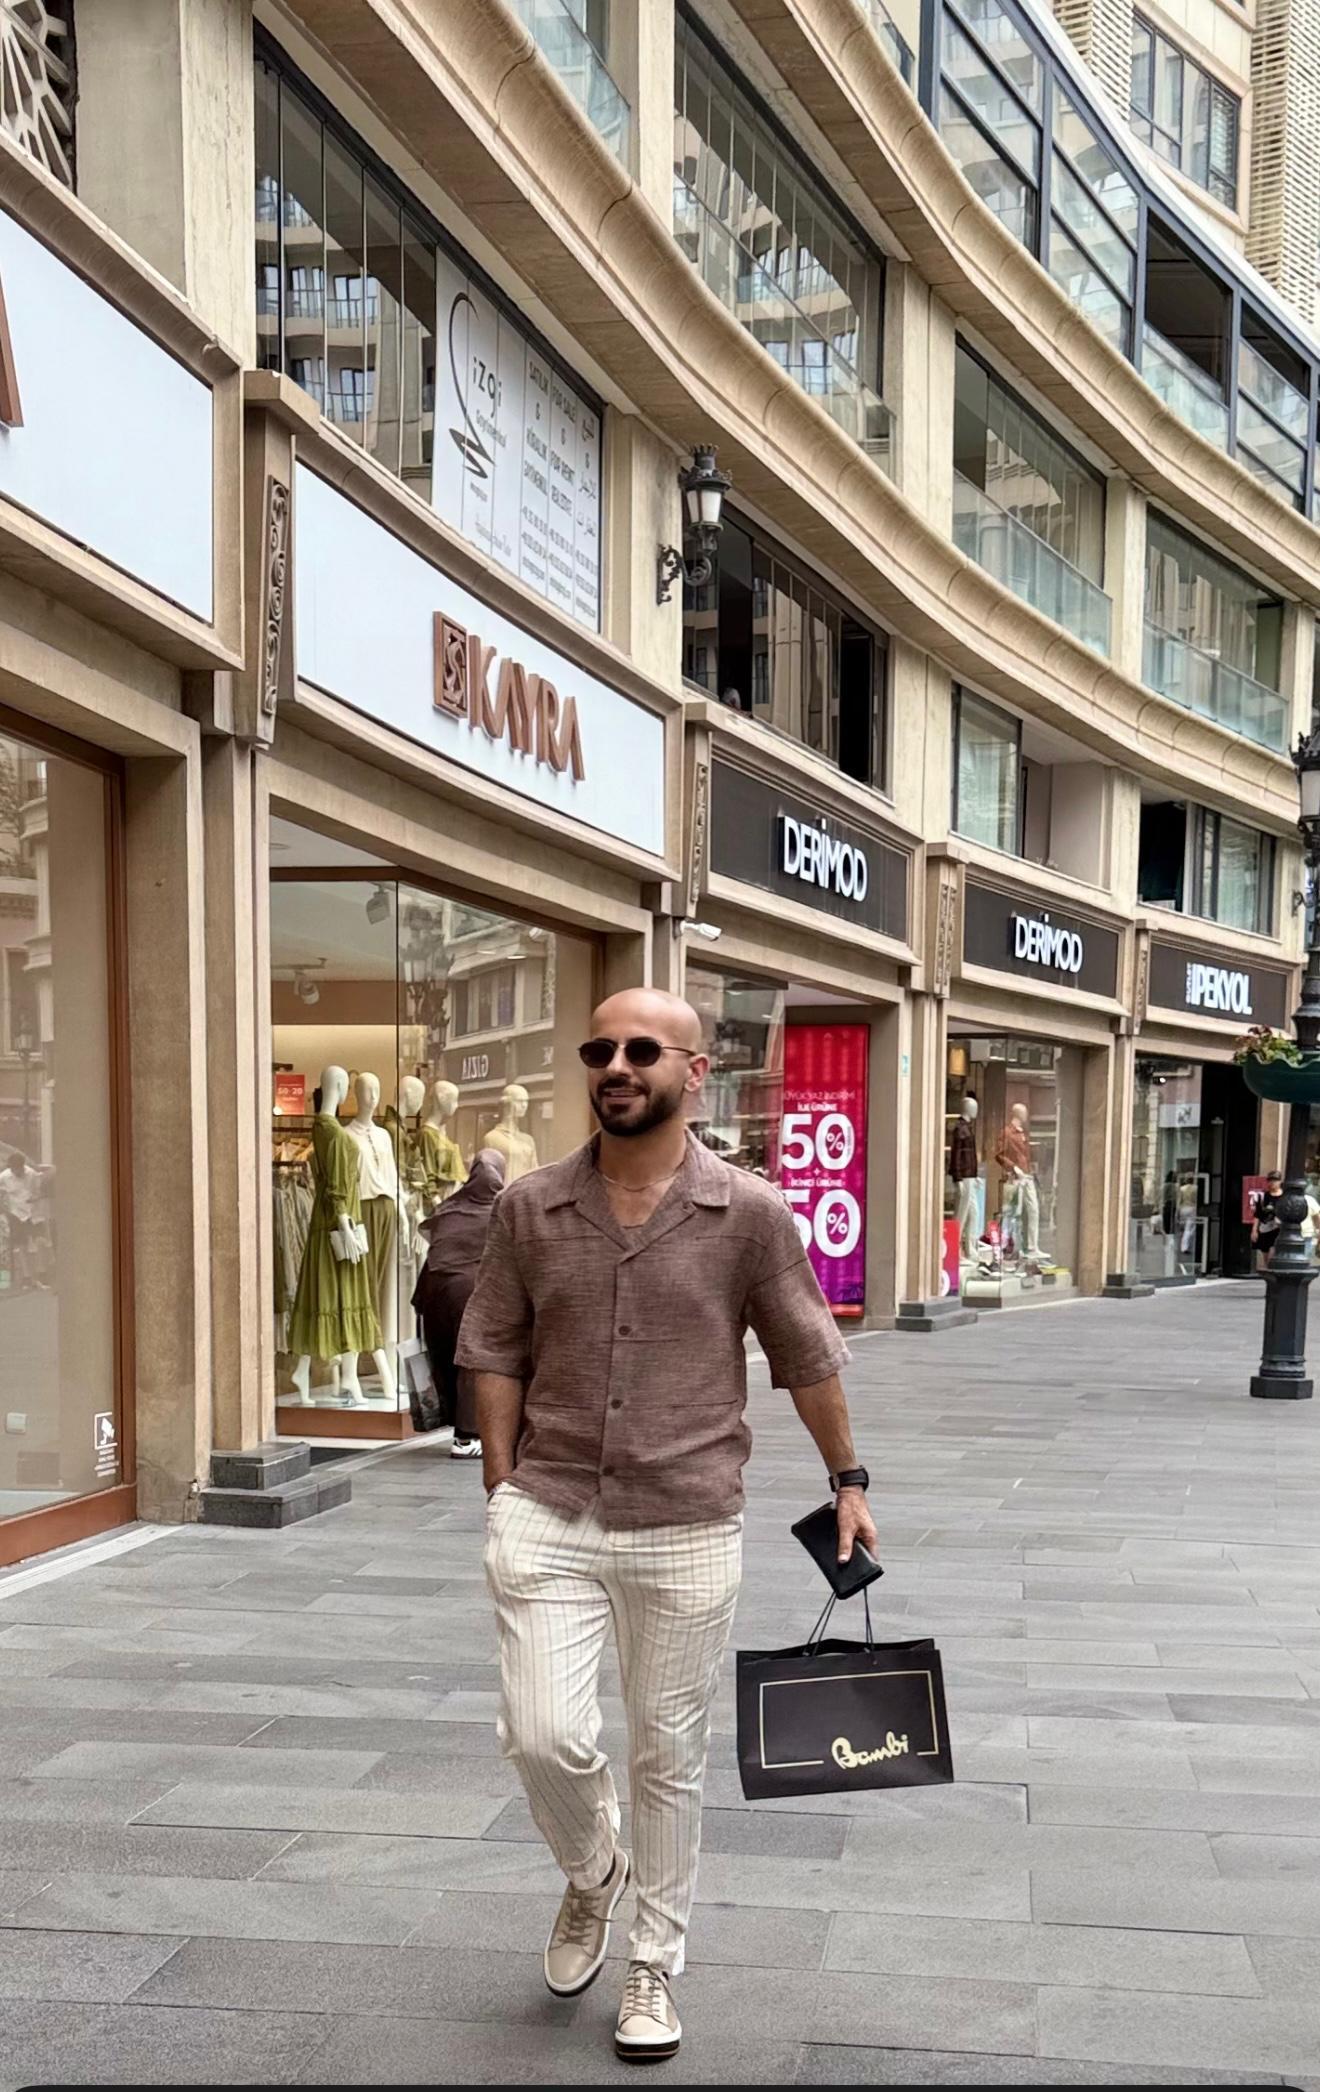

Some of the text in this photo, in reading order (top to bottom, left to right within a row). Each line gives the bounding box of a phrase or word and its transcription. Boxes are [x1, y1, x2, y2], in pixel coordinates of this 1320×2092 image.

[469, 635, 584, 781] KAYRA
[783, 815, 868, 902] DERİMOD
[831, 1731, 909, 1770] Bambi
